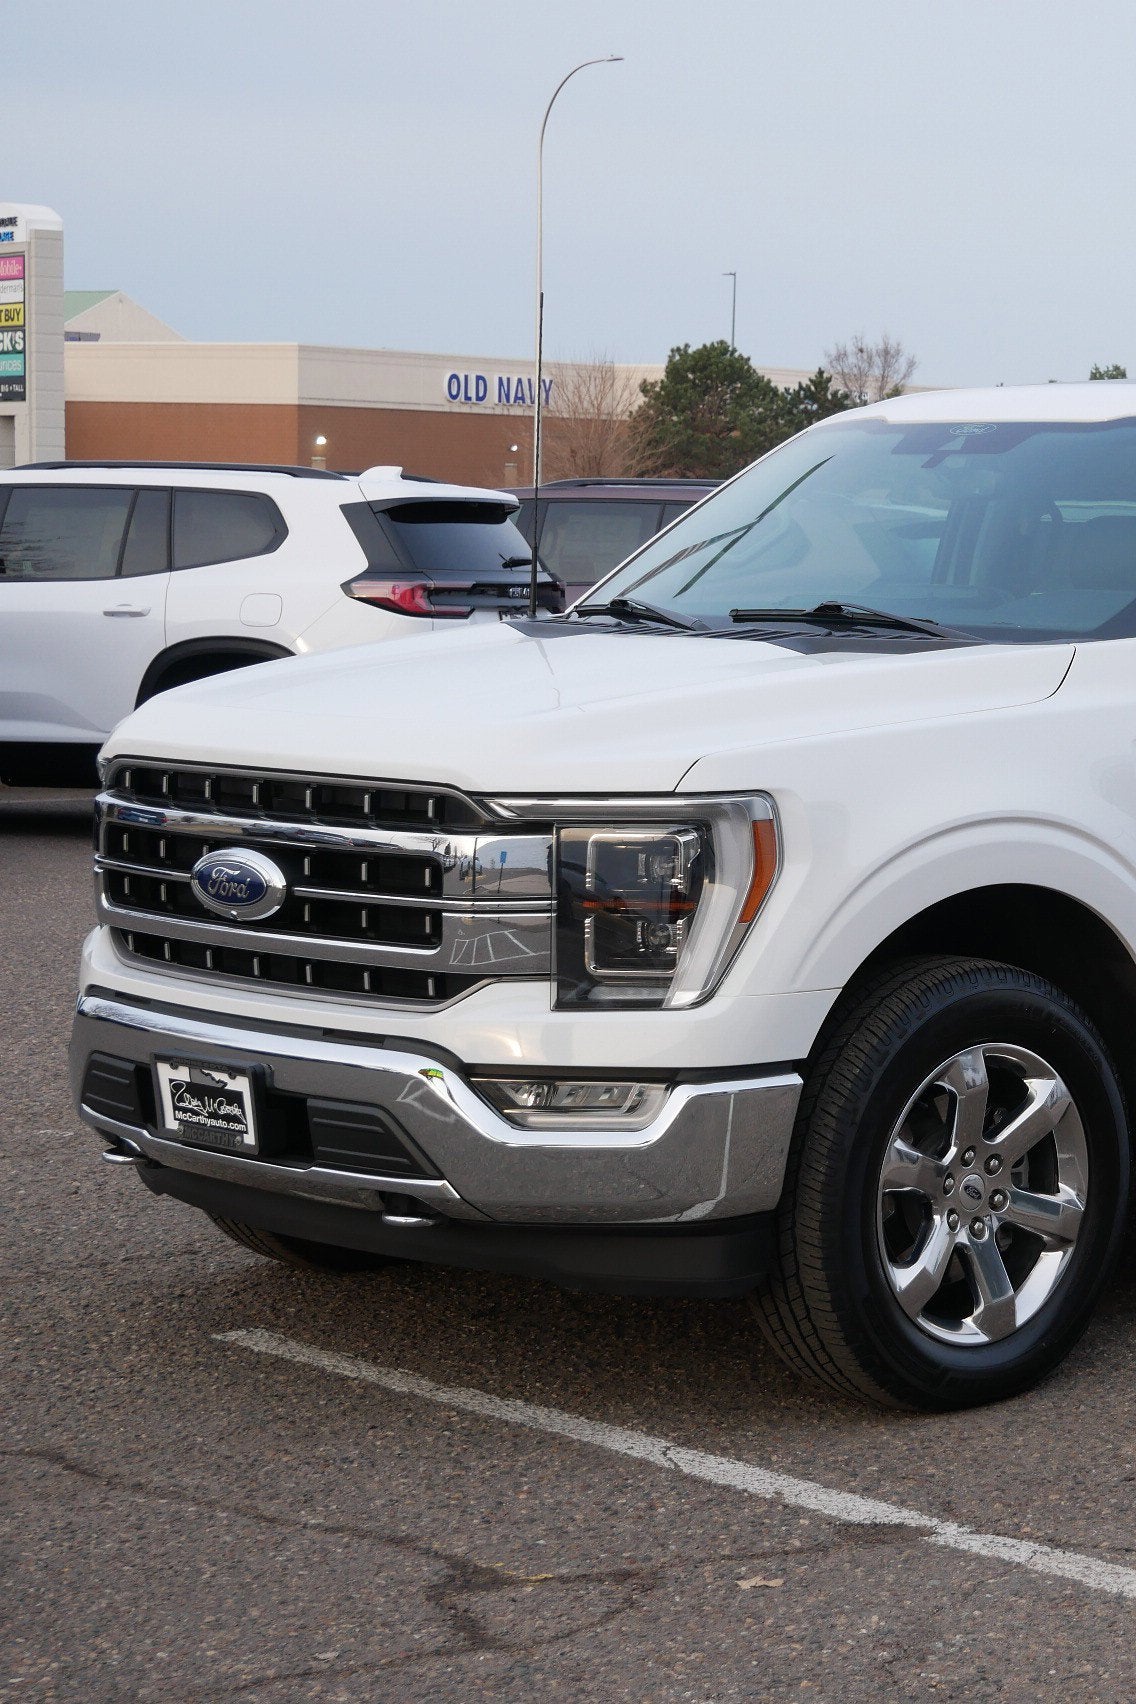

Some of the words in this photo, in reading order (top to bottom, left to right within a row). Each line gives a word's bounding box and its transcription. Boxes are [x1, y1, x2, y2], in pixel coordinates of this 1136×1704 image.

[4, 308, 21, 322] BUY
[447, 373, 488, 402] OLD
[207, 866, 251, 899] Ford
[174, 1110, 247, 1132] McCarthyauto.com
